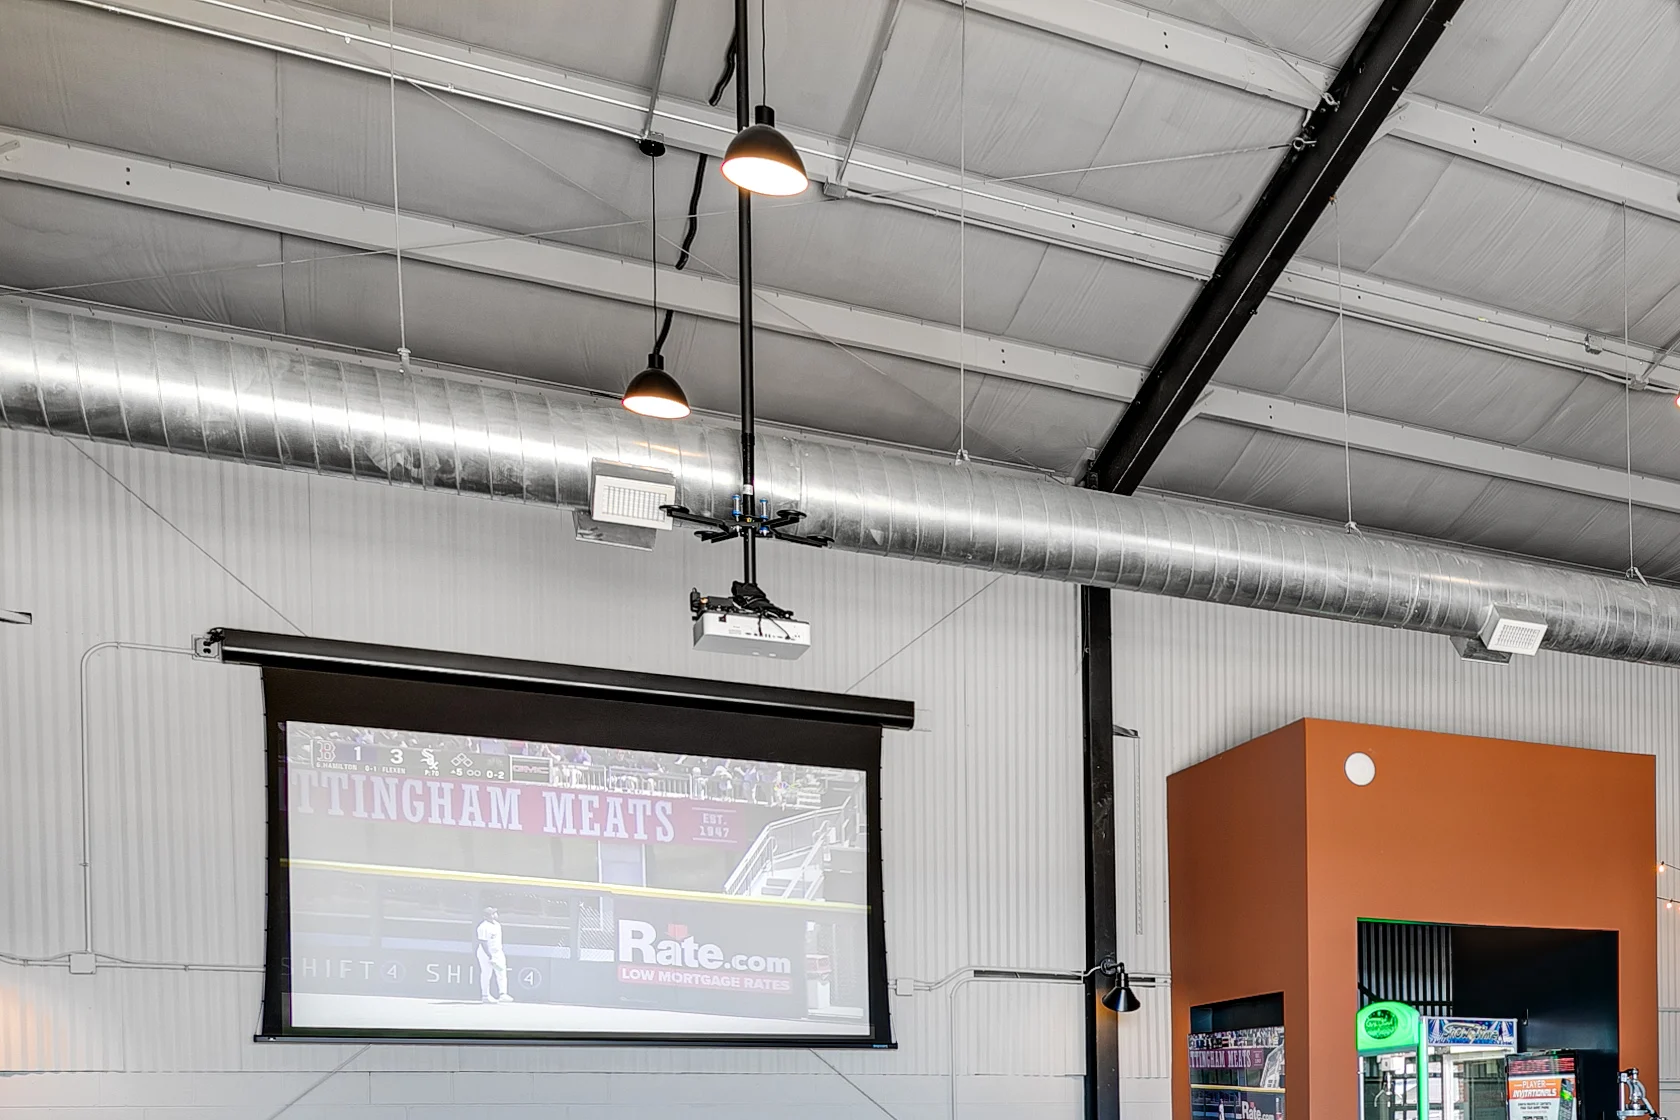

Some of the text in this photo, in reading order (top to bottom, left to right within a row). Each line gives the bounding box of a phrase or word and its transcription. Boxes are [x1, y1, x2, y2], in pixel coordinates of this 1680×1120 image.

[354, 746, 361, 761] 1
[390, 748, 404, 764] 3
[456, 768, 463, 776] 5
[486, 770, 505, 779] 0-2
[512, 765, 549, 774] GMC
[290, 768, 676, 843] TTINGHAM MEATS
[702, 813, 727, 825] EST.
[618, 919, 792, 974] Rate.com
[622, 967, 791, 991] LOW MORTGAGE RATES
[1522, 1080, 1546, 1088] PLAYER
[1242, 1101, 1274, 1120] Rate.com
